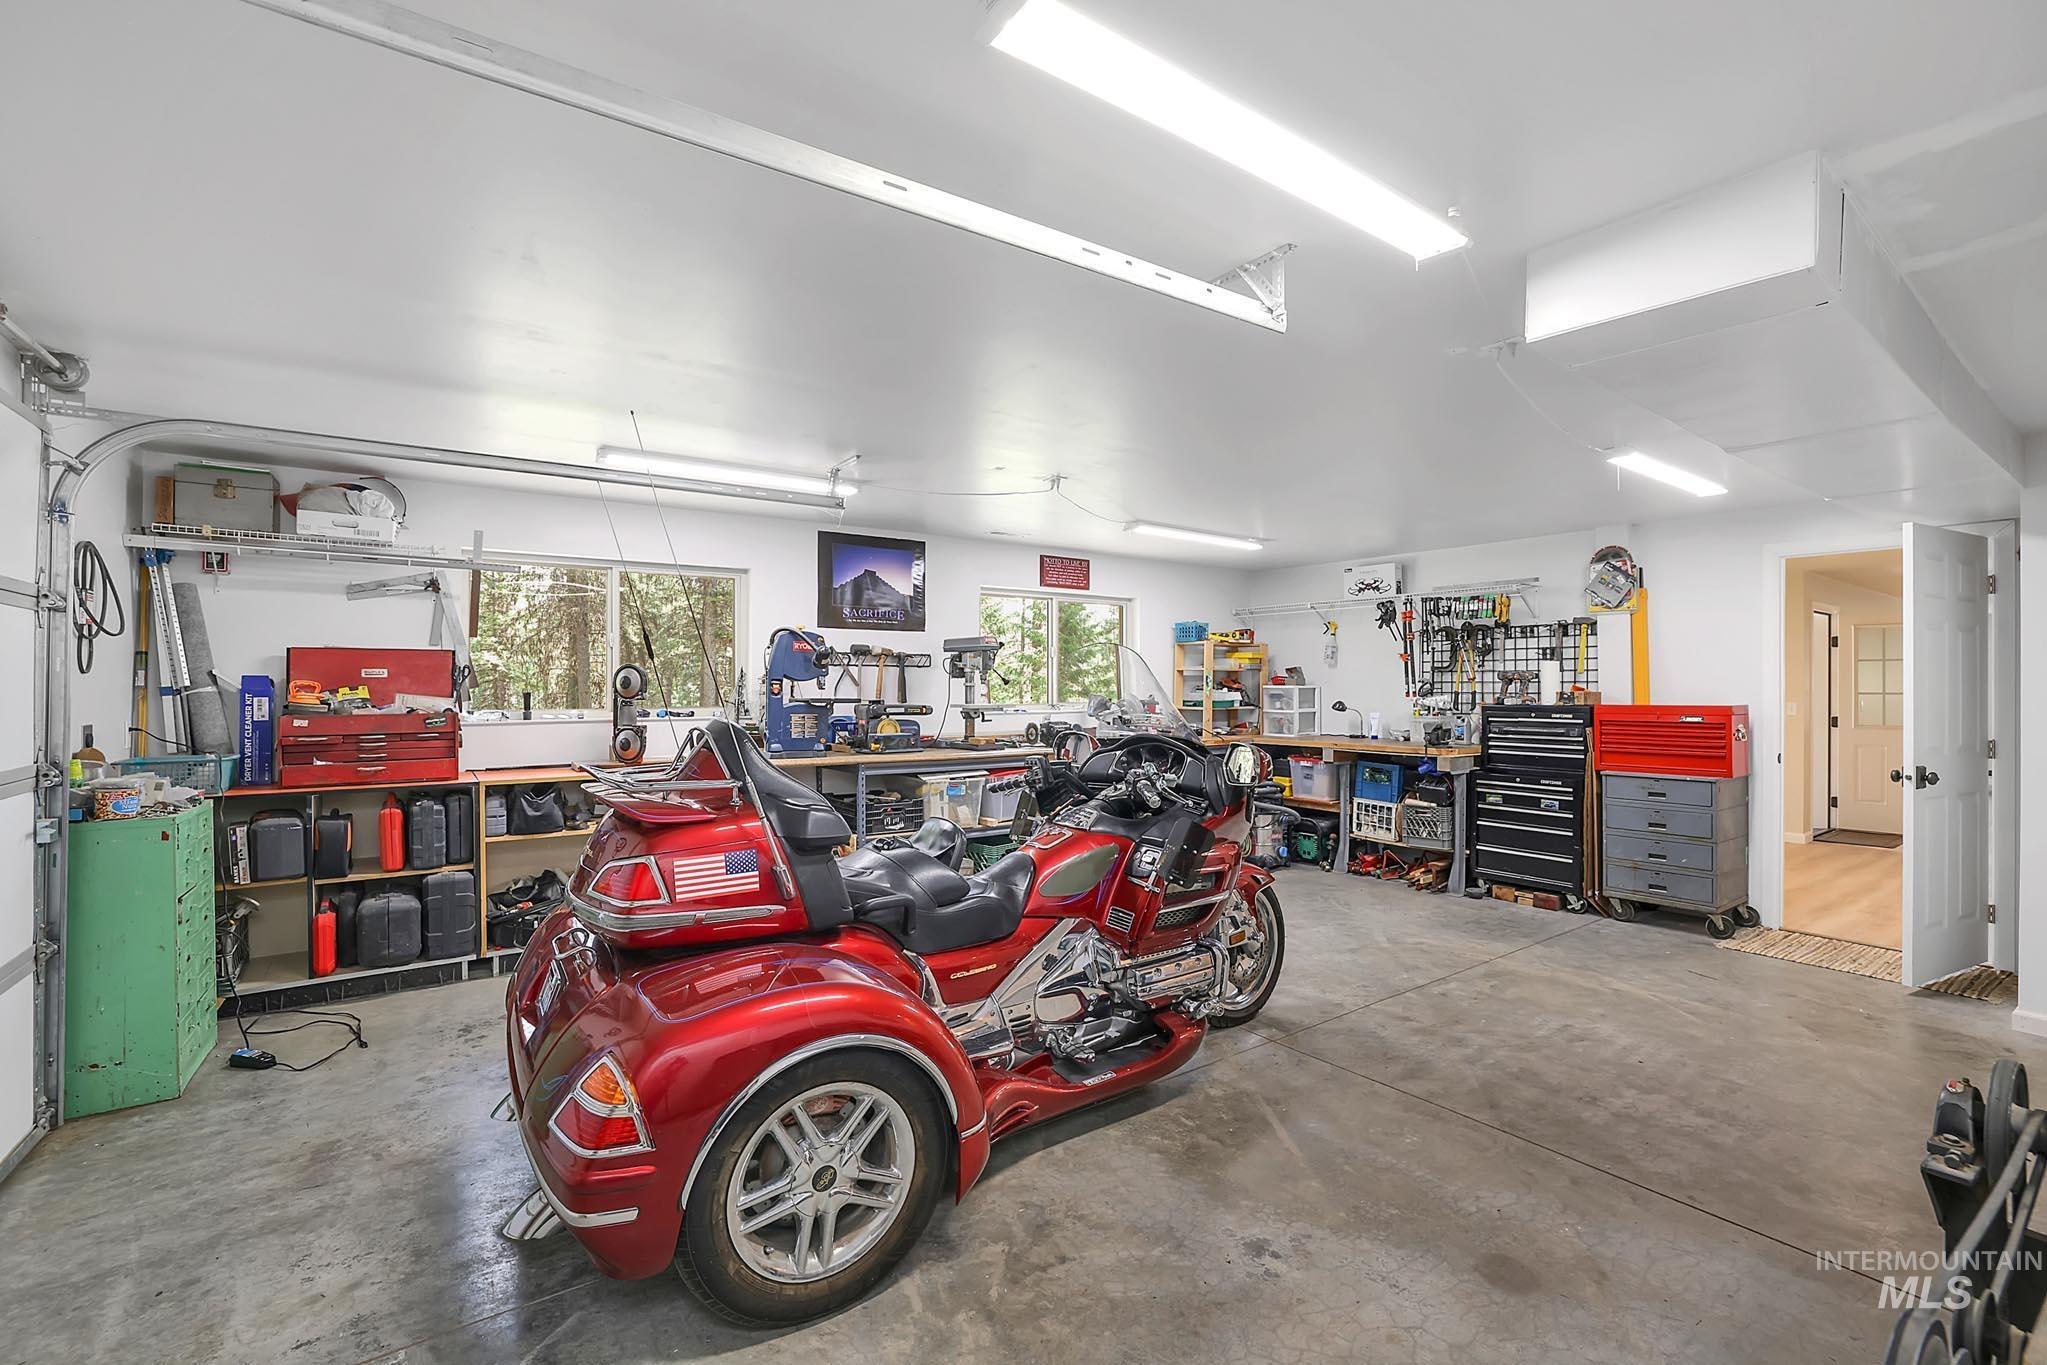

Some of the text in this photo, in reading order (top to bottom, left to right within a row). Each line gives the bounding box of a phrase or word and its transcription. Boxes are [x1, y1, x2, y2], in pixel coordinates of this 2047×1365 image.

[842, 607, 905, 621] SACRIFICE
[244, 693, 253, 781] DRYER VENT CLEANER KIT
